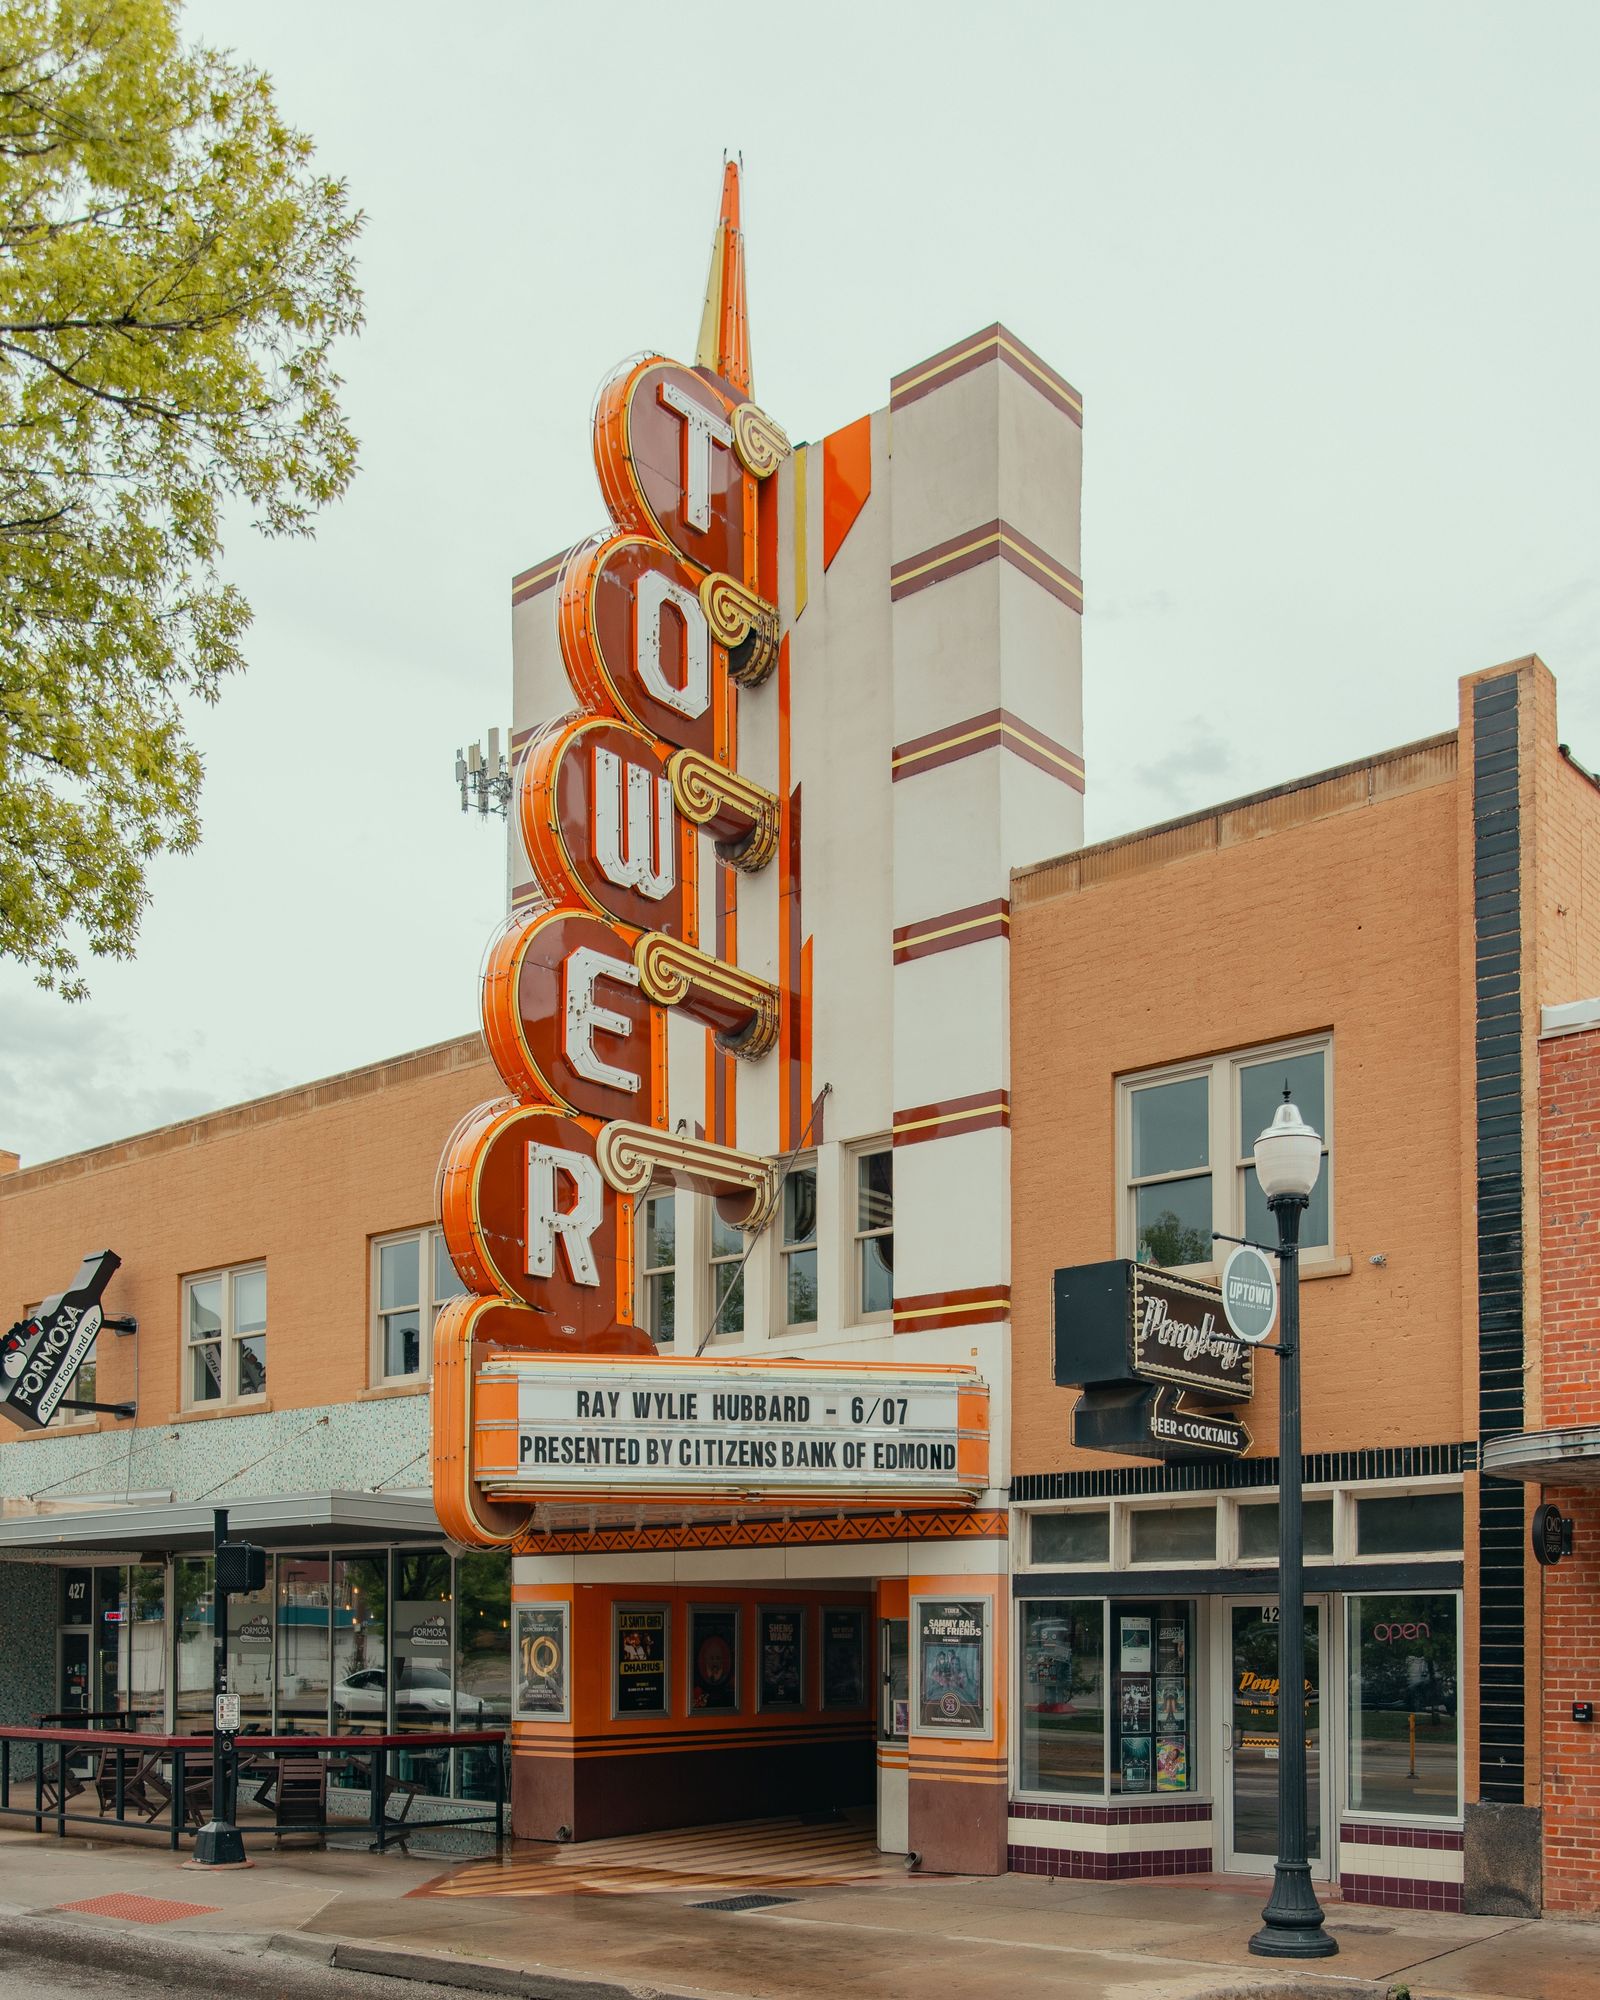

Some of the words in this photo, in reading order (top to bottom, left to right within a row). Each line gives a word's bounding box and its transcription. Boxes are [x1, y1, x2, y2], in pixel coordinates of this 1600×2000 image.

[524, 381, 733, 1288] TOWER
[1229, 1281, 1272, 1306] UPTOWN
[14, 1305, 84, 1406] FORMOSA
[40, 1384, 62, 1414] Street
[58, 1354, 77, 1382] Food
[75, 1336, 88, 1356] and
[85, 1317, 99, 1336] Bar
[577, 1390, 620, 1418] RAY
[632, 1392, 698, 1420] WYLIE
[712, 1394, 810, 1423] HUBBARD
[851, 1396, 908, 1425] 6/07
[1150, 1416, 1177, 1435] BEER
[1183, 1423, 1239, 1446] COCKTAILS
[520, 1435, 640, 1465] PRESENTED
[646, 1438, 673, 1465] BY
[679, 1438, 777, 1468] CITIZENS
[782, 1440, 837, 1468] BANK
[843, 1441, 866, 1469] OF
[873, 1442, 956, 1470] EDMOND
[68, 1583, 86, 1599] 427
[928, 1619, 957, 1628] SAMMY
[958, 1619, 976, 1628] RAE
[1263, 1607, 1279, 1622] 42
[241, 1626, 270, 1635] FORMOSA
[412, 1627, 447, 1637] FORMOSA
[923, 1626, 930, 1635] &
[931, 1626, 946, 1635] THE
[947, 1627, 982, 1636] FRIENDS
[1374, 1622, 1430, 1645] open
[623, 1662, 660, 1673] DHARIUS
